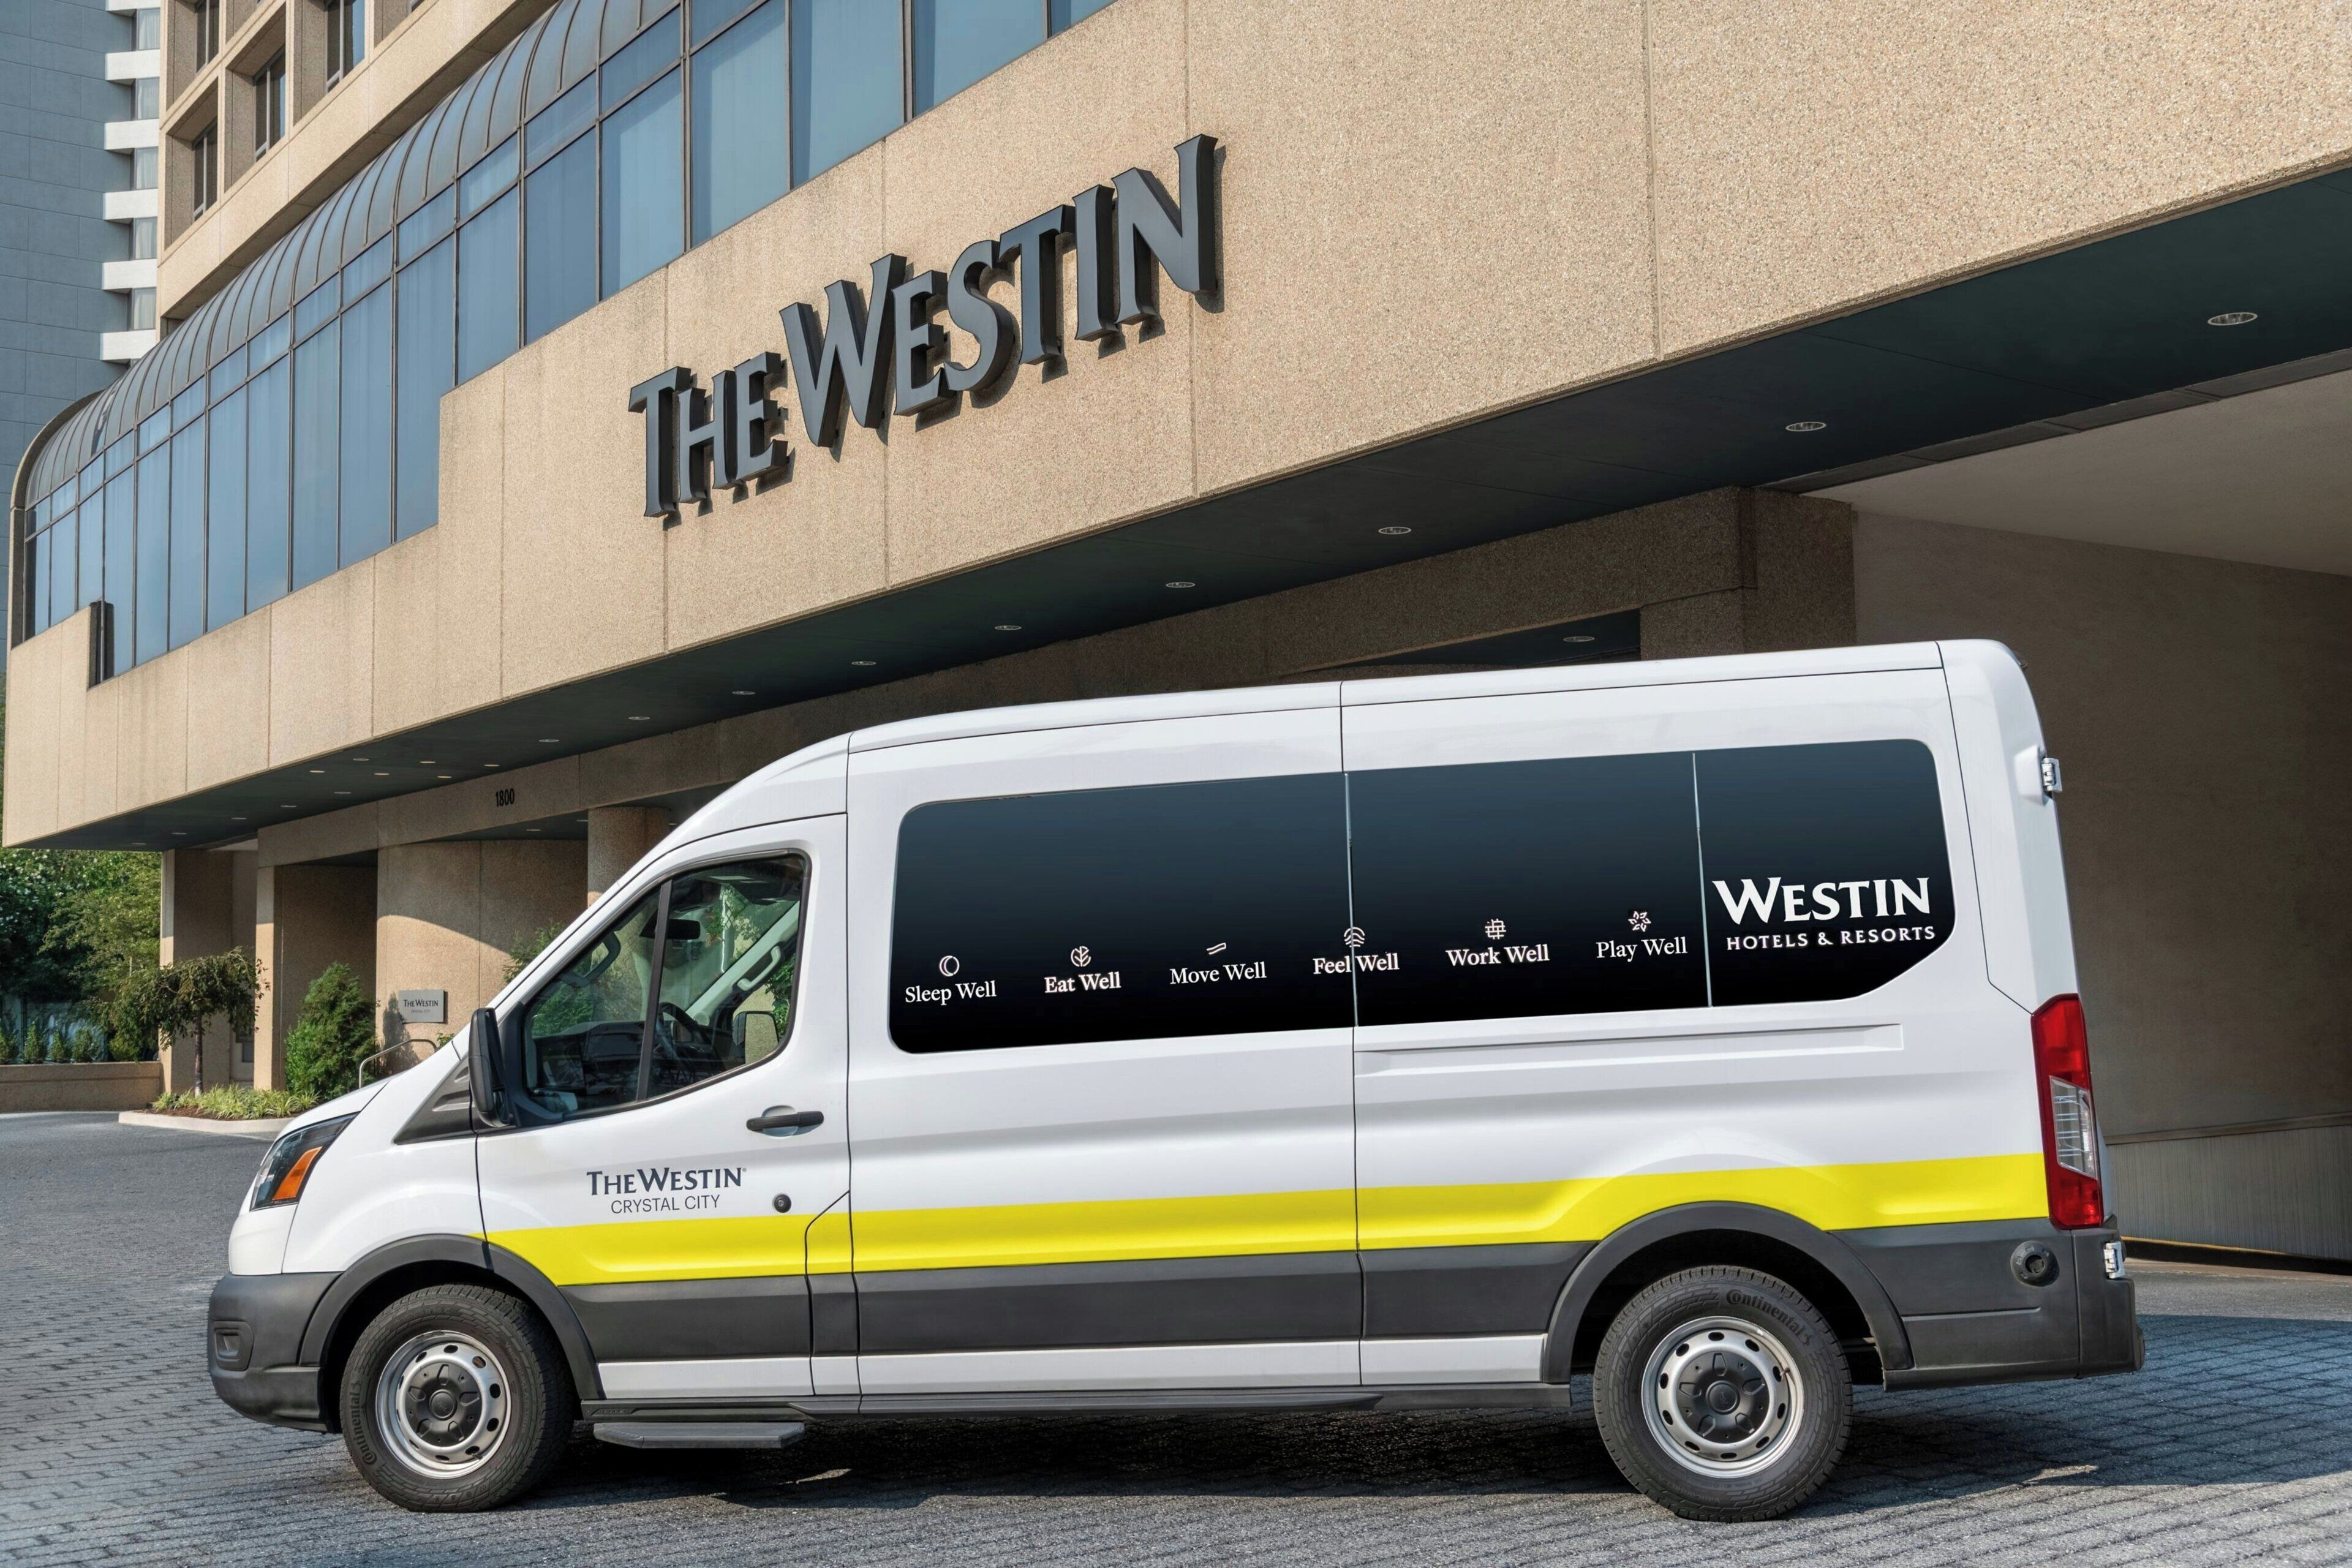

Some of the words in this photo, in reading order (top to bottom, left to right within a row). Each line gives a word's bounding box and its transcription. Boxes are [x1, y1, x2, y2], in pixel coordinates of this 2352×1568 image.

[628, 352, 787, 518] THE
[779, 134, 1219, 448] WESTIN
[496, 788, 515, 807] 1800
[1712, 876, 1930, 925] WESTIN
[1596, 940, 1638, 962] Play
[1640, 936, 1688, 956] Well
[1726, 933, 1808, 951] HOTELS
[1817, 932, 1833, 946] &
[1840, 925, 1936, 944] RESORTS
[1313, 955, 1351, 975] Feel
[1355, 952, 1400, 973] Well
[1446, 946, 1501, 967] Work
[1504, 943, 1550, 963] Well
[1044, 976, 1076, 994] Eat
[1079, 971, 1121, 991] Well
[1169, 967, 1220, 985] Move
[1223, 961, 1267, 981] Well
[404, 999, 415, 1008] THE
[415, 998, 439, 1007] WESTIN
[904, 985, 952, 1006] Sleep
[956, 980, 997, 1000] Well
[586, 1170, 637, 1196] THE
[636, 1167, 742, 1192] WESTIN
[611, 1197, 680, 1214] CRYSTAL
[684, 1194, 720, 1210] CITY
[1726, 1288, 1803, 1340] Continental
[350, 1390, 378, 1466] Continental
